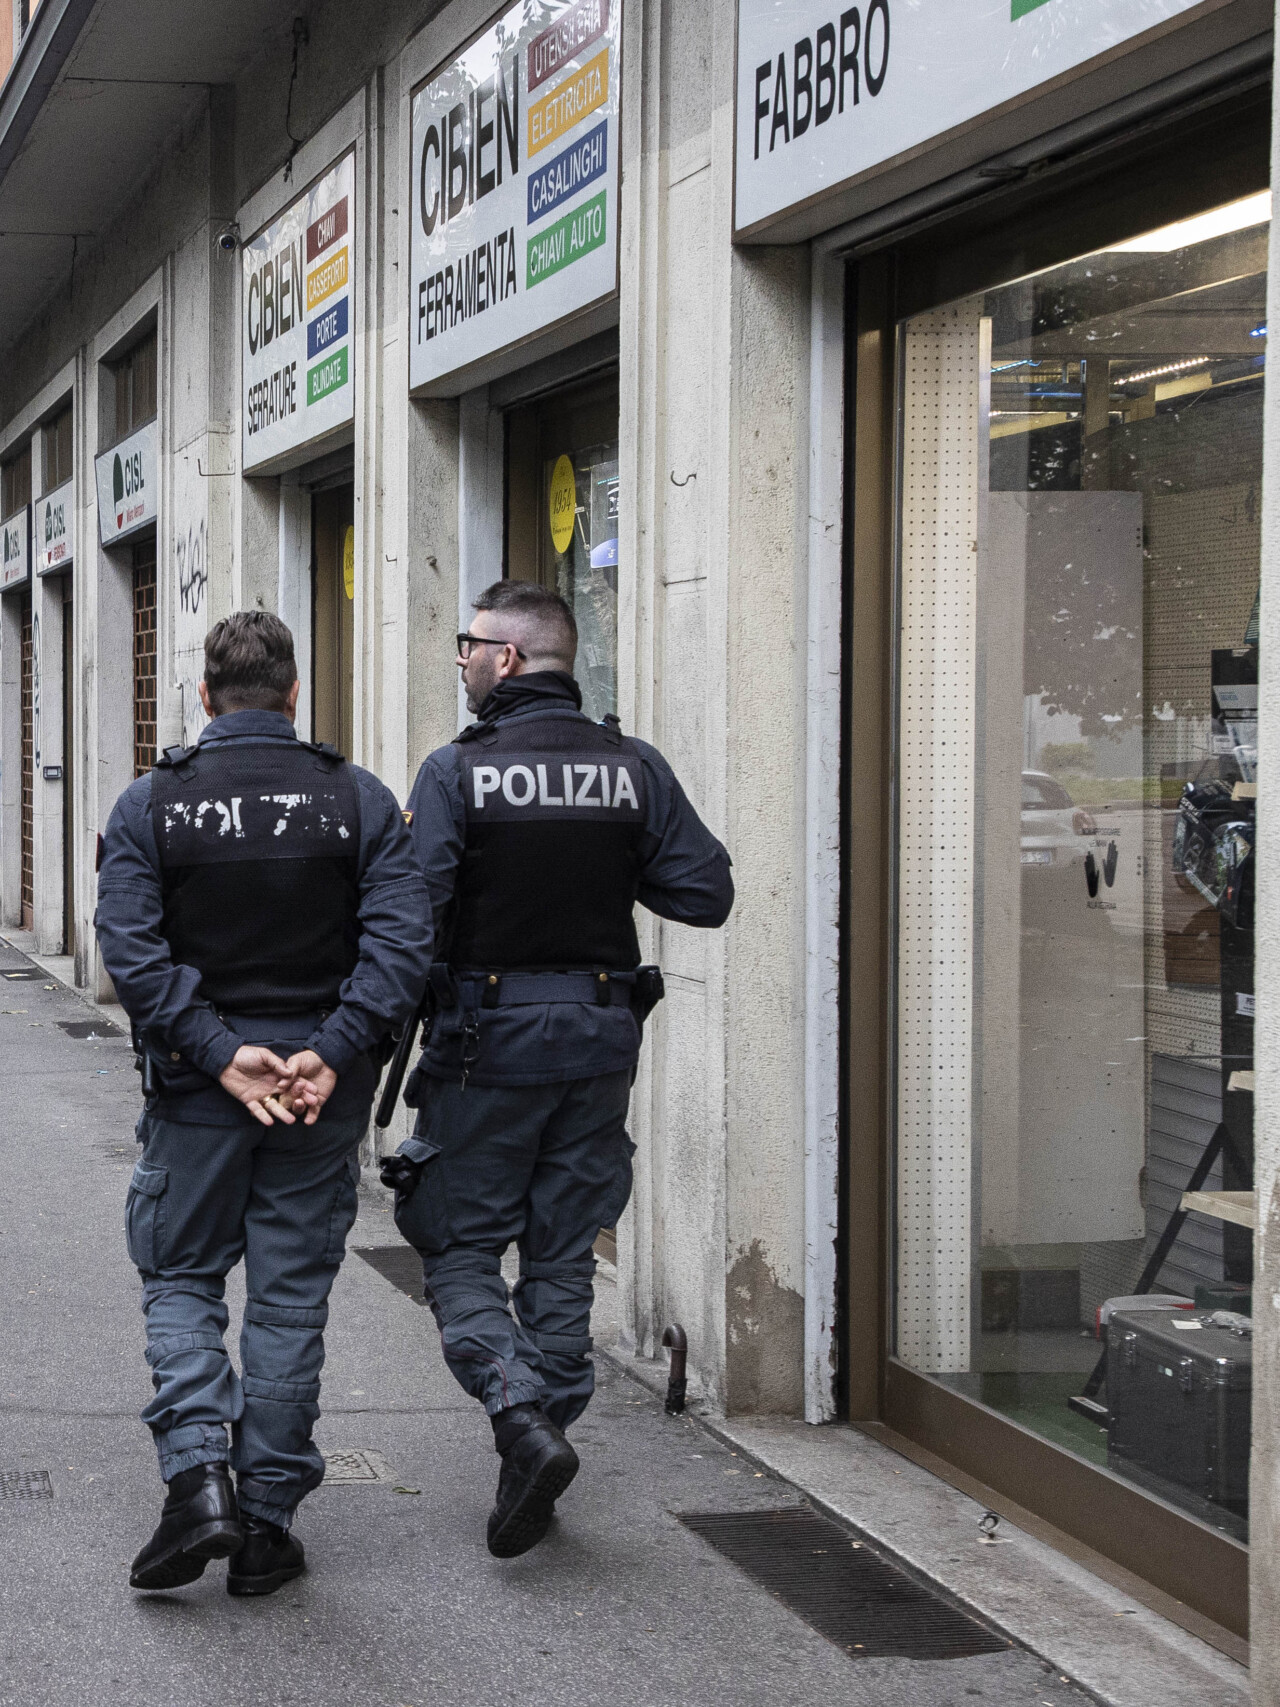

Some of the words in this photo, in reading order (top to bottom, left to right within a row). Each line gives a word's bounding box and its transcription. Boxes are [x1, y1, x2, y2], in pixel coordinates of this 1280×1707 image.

[532, 66, 601, 145] ELETTRICITA
[754, 0, 891, 160] FABBRO
[420, 53, 519, 236] CIBIEN
[532, 132, 602, 213] CASALINGHI
[317, 212, 335, 249] CHIAVI
[530, 234, 566, 277] CHIAVI
[570, 204, 602, 254] AUTO
[248, 234, 302, 356] CIBIEN
[308, 254, 346, 303] CASSEFORTI
[418, 226, 517, 345] FERRAMENTA
[316, 310, 337, 348] PORTE
[248, 361, 297, 436] SERRATURE
[312, 357, 341, 397] BLINDATE
[125, 451, 144, 497] CISL
[553, 487, 571, 515] 1954
[53, 503, 65, 539] CISL
[472, 764, 638, 810] POLIZIA
